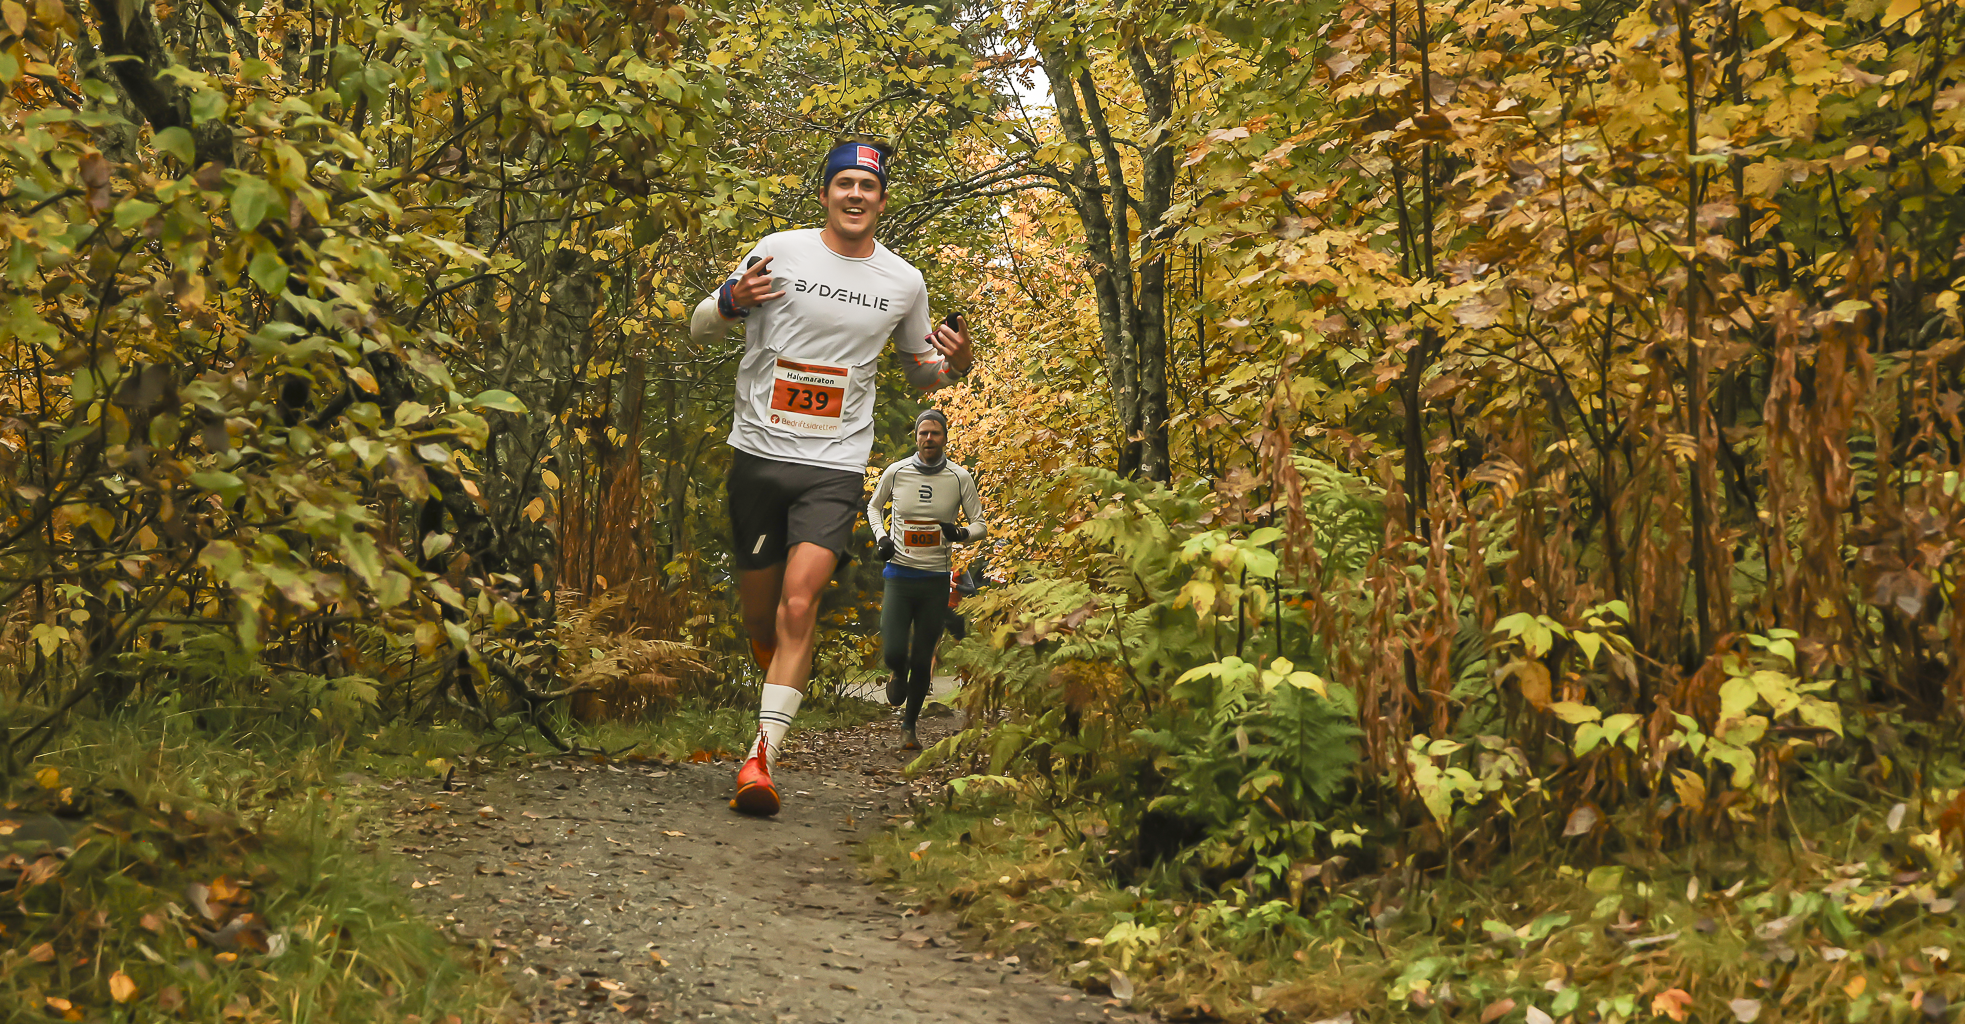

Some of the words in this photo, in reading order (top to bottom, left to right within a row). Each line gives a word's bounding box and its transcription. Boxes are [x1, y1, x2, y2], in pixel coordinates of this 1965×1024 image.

[787, 372, 835, 384] Halvmaraton
[787, 387, 829, 410] 739
[911, 533, 934, 545] 803
